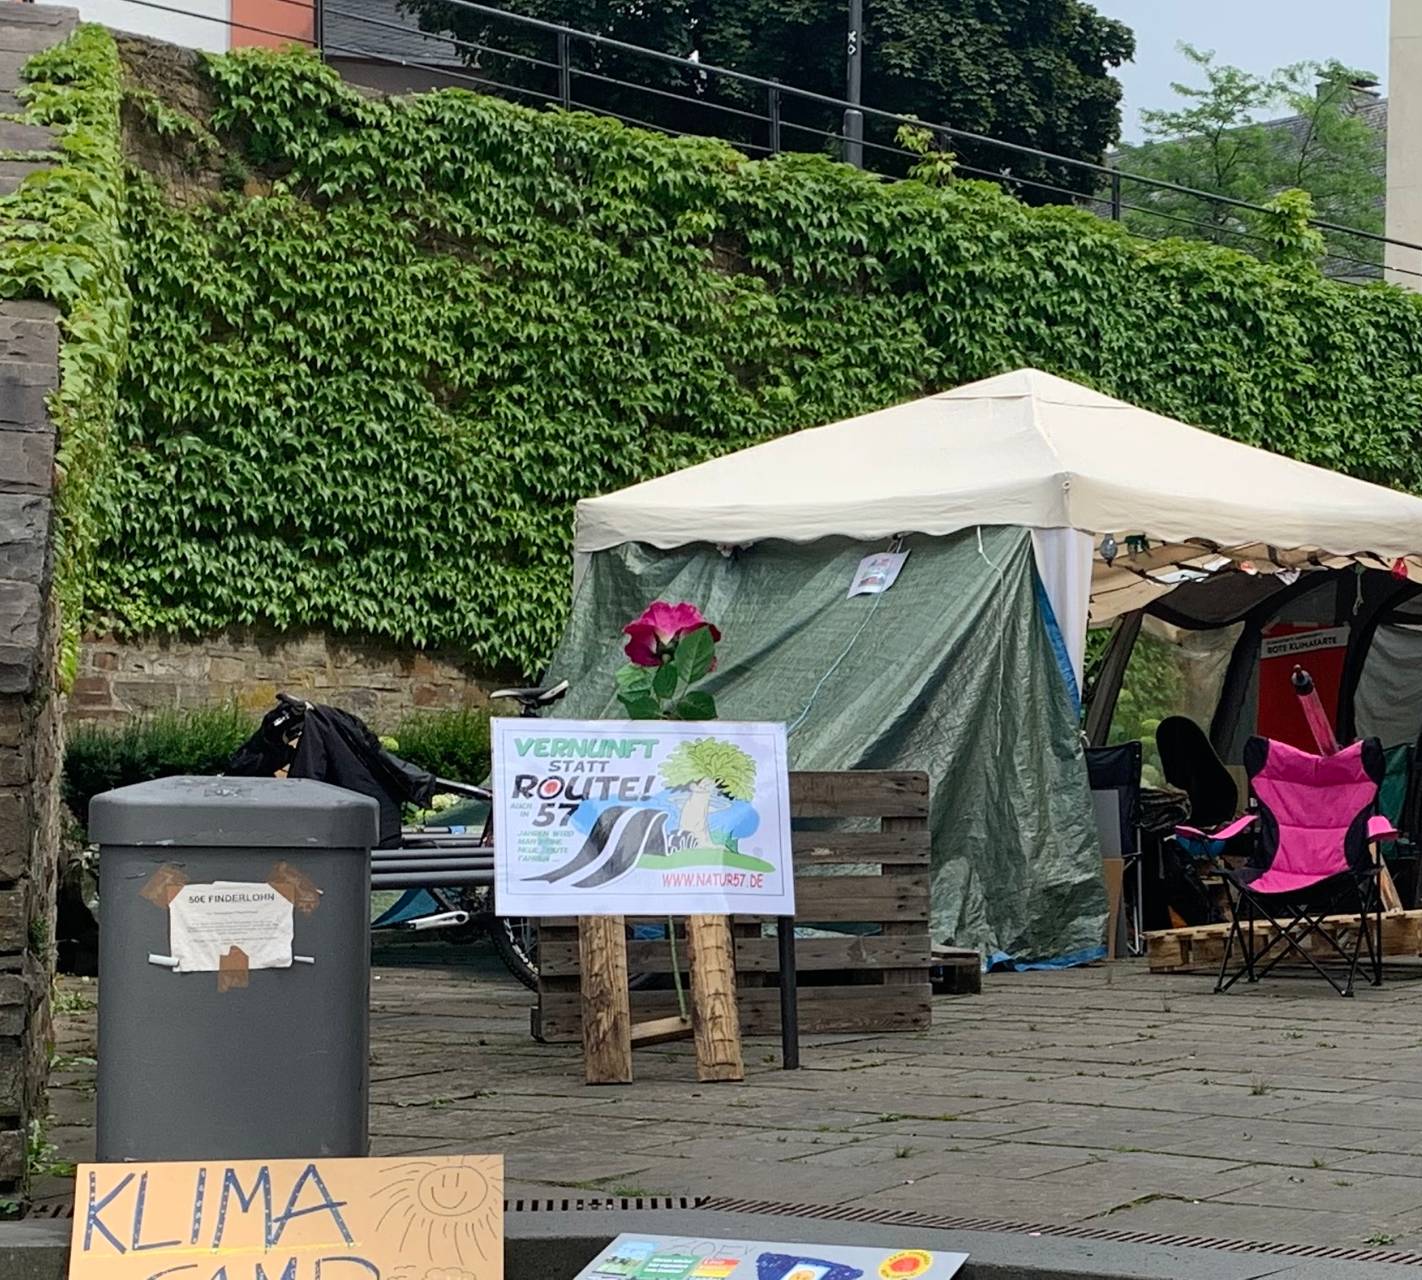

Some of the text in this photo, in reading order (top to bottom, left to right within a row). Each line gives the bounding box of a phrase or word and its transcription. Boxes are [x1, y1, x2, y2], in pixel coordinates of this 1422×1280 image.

[514, 737, 660, 759] VERNUNFT
[548, 759, 611, 773] STATT
[511, 774, 656, 801] ROUTE!
[532, 803, 580, 828] 57
[662, 872, 765, 889] WWW.NATUR57.DE
[188, 893, 275, 904] 50€ FINDERLOHN
[83, 1163, 358, 1256] KLIMA
